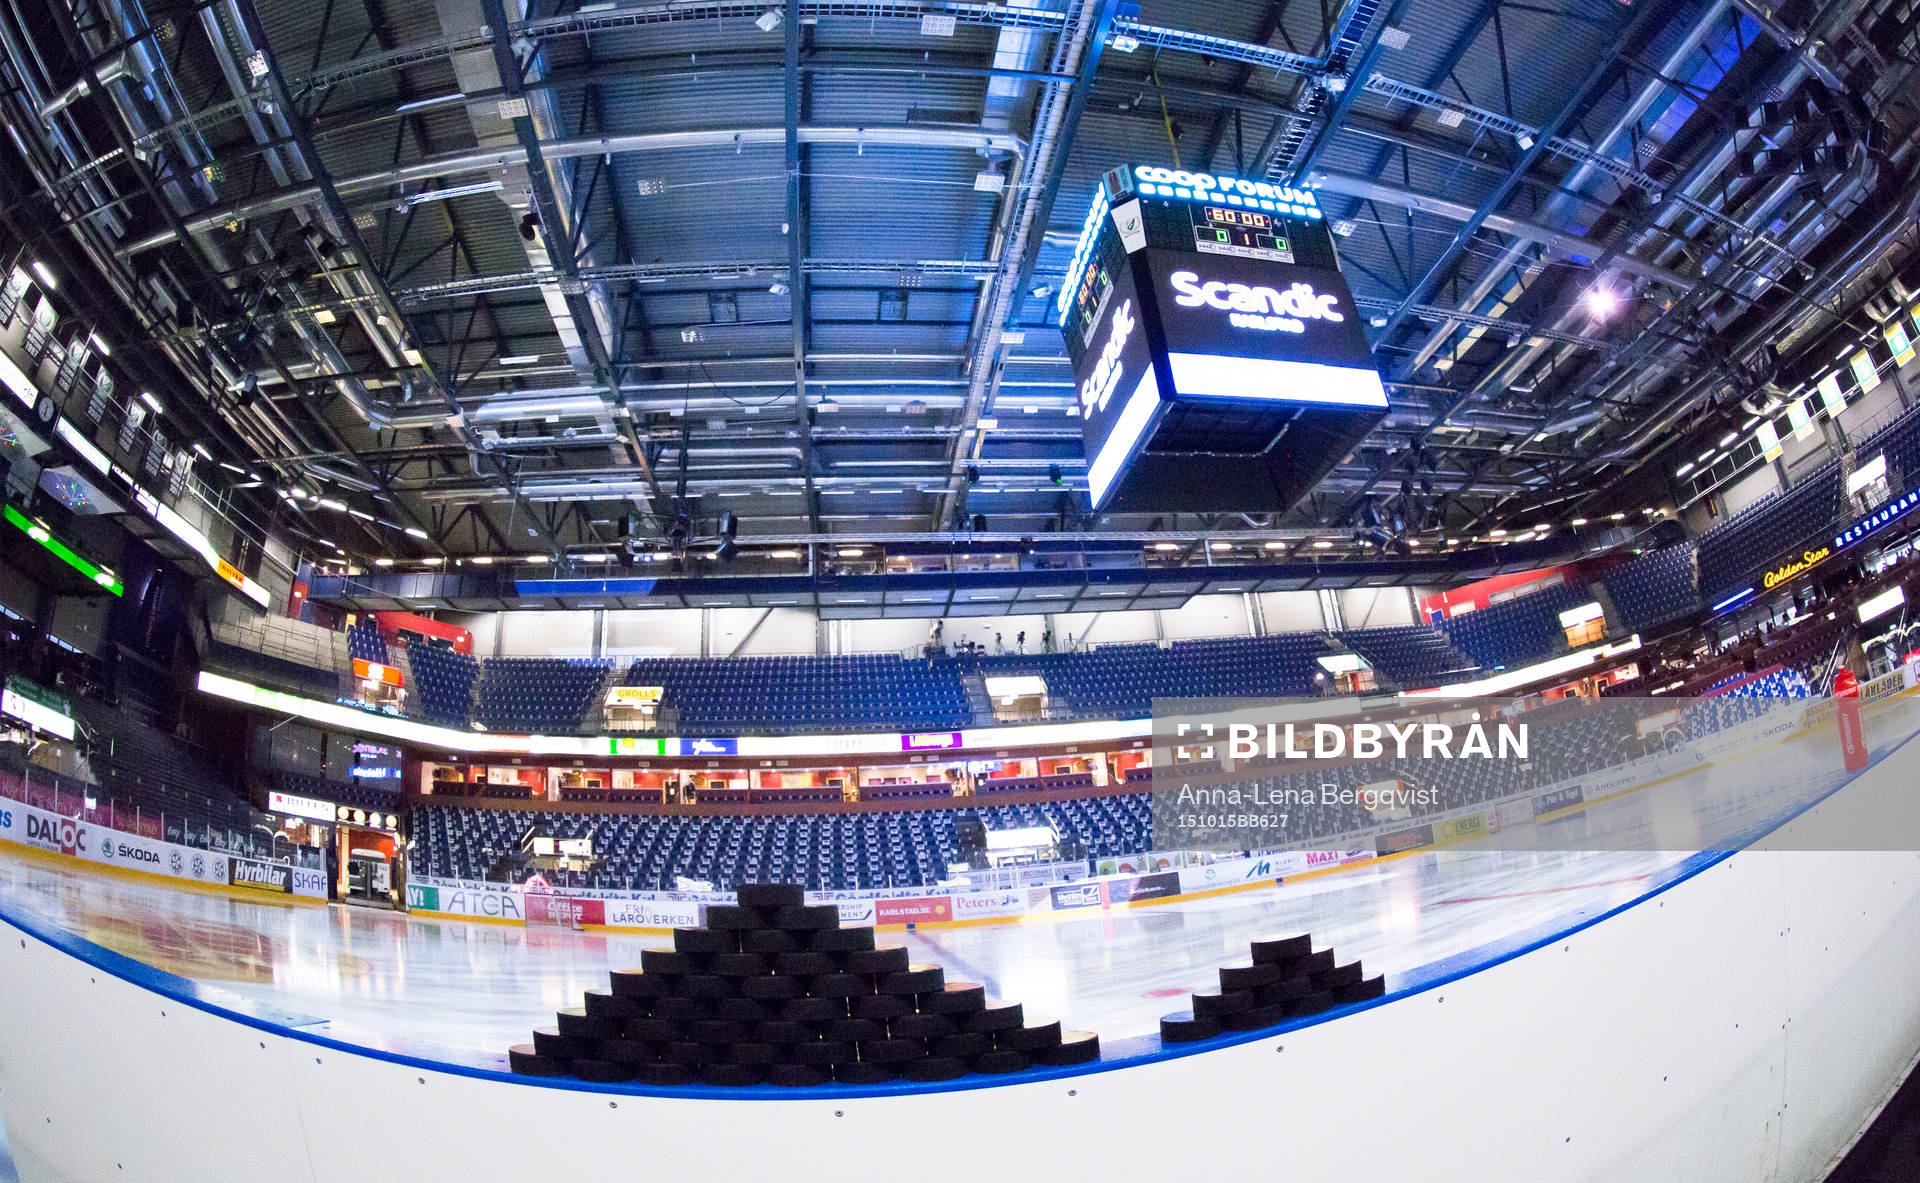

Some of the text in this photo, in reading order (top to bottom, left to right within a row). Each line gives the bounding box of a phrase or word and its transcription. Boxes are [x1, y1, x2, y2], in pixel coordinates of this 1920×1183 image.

[1217, 175, 1318, 207] FORUM
[1211, 207, 1265, 227] 60:00
[1215, 229, 1228, 243] 0
[1243, 233, 1250, 246] 1
[1275, 238, 1288, 252] 0
[1170, 270, 1344, 322] Scandic
[1835, 487, 1920, 548] RESTAURAN
[1764, 546, 1830, 588] Golden Star
[617, 689, 657, 699] GROLLS
[1594, 774, 1637, 793] Anticimex
[26, 814, 87, 852] DALOC
[118, 843, 161, 865] ŠKODA
[1306, 850, 1339, 865] MAXI
[235, 860, 287, 886] Hyrbilar
[447, 891, 520, 918] ATEA
[879, 906, 931, 917] KARLSTAD.SE
[957, 896, 997, 909] Peters
[613, 912, 694, 925] LÄROVERKEN
